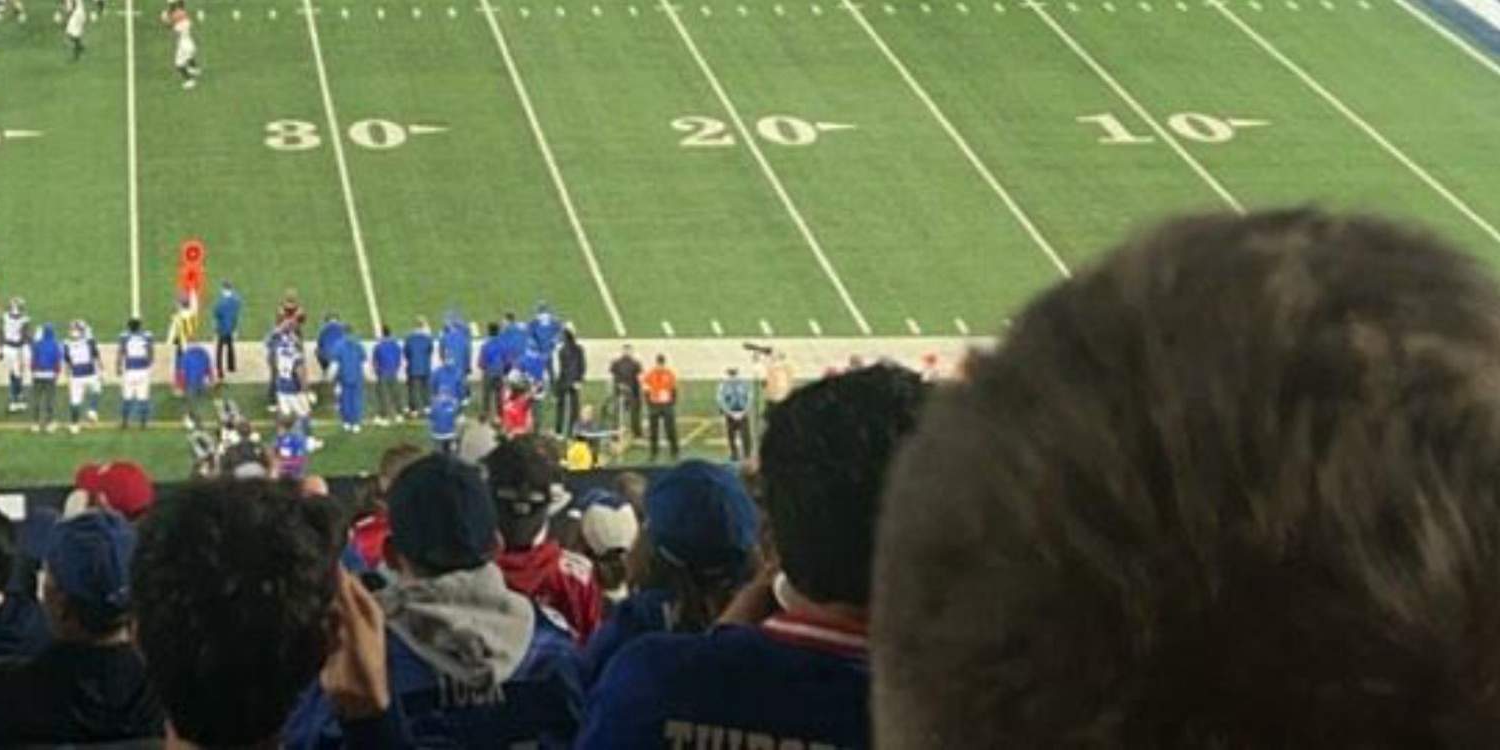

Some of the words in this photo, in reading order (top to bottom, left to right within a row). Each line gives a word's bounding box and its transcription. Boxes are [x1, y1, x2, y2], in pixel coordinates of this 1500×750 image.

[264, 118, 407, 150] 30
[670, 115, 817, 146] 20
[1076, 113, 1233, 143] 10
